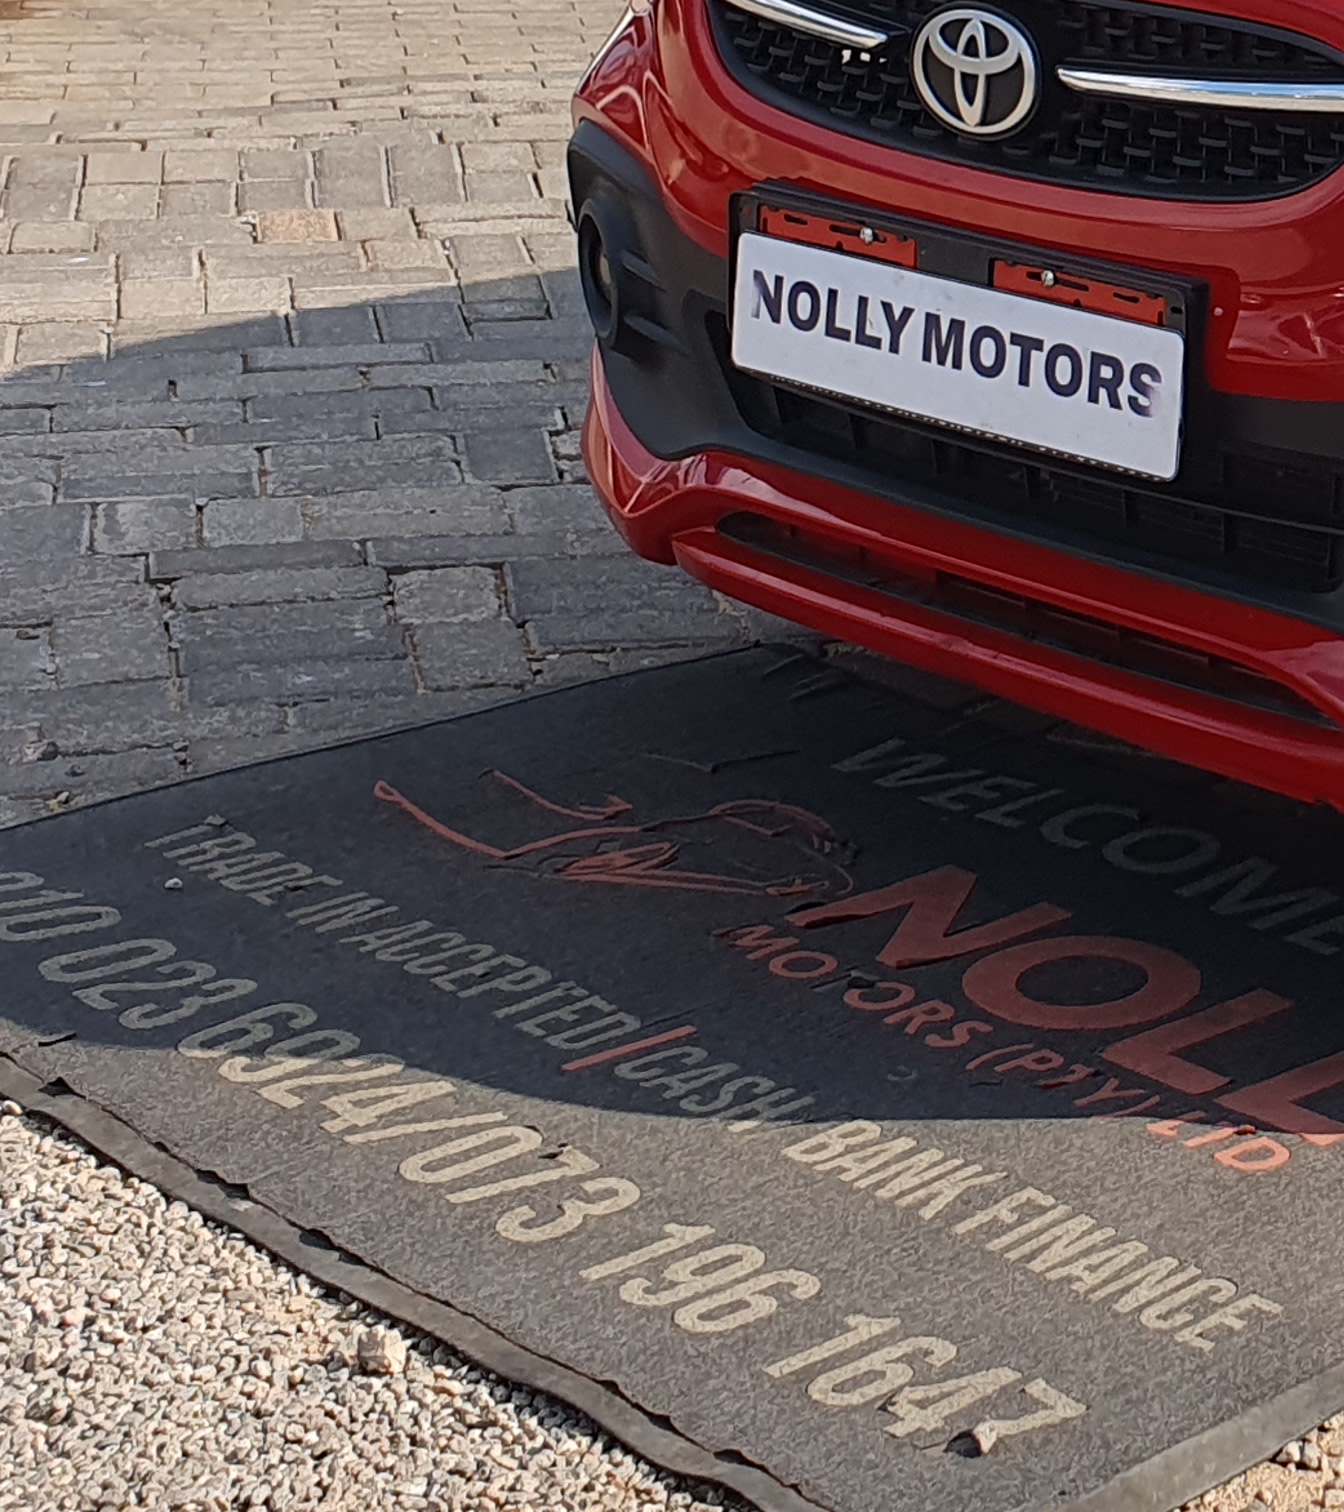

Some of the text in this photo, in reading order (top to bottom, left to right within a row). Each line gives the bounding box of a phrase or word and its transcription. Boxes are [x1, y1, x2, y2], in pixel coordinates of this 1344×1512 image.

[752, 270, 1162, 419] NOLLY MOTORS
[38, 938, 259, 1030] 023
[579, 1222, 821, 1334] 196
[765, 1312, 1088, 1440] 1647
[144, 816, 344, 907] TRADE
[286, 892, 399, 934] IN
[781, 1119, 1008, 1222] BANK
[956, 1187, 1283, 1351] FINANCE
